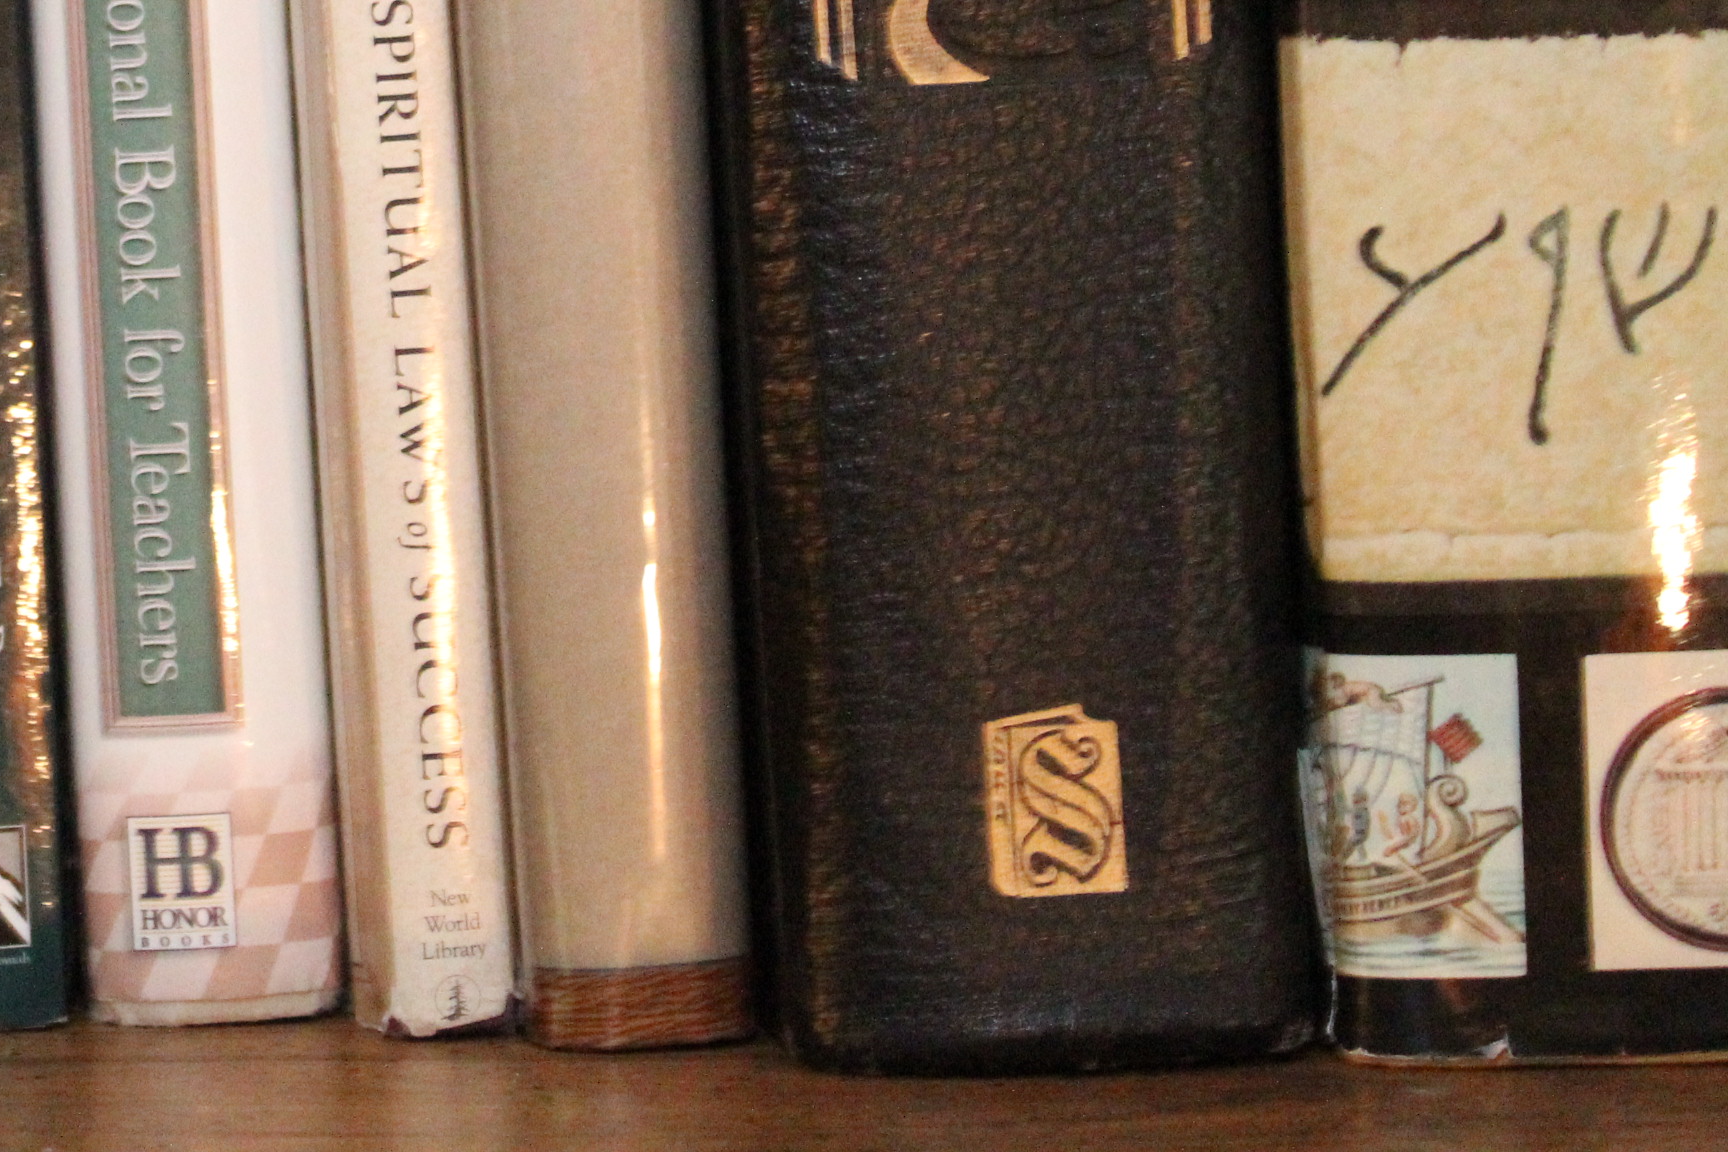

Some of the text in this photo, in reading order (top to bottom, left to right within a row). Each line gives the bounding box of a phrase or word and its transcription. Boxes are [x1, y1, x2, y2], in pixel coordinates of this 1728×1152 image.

[110, 148, 183, 304] Book
[122, 328, 186, 412] for
[393, 346, 443, 506] LAWS
[126, 420, 197, 685] Teachers
[397, 521, 434, 552] of
[408, 575, 469, 849] SUCCESS
[137, 826, 225, 901] HB
[139, 906, 229, 932] HONOR
[423, 912, 482, 933] World
[429, 889, 471, 908] New
[140, 933, 231, 949] BOOKS
[421, 941, 487, 961] Library
